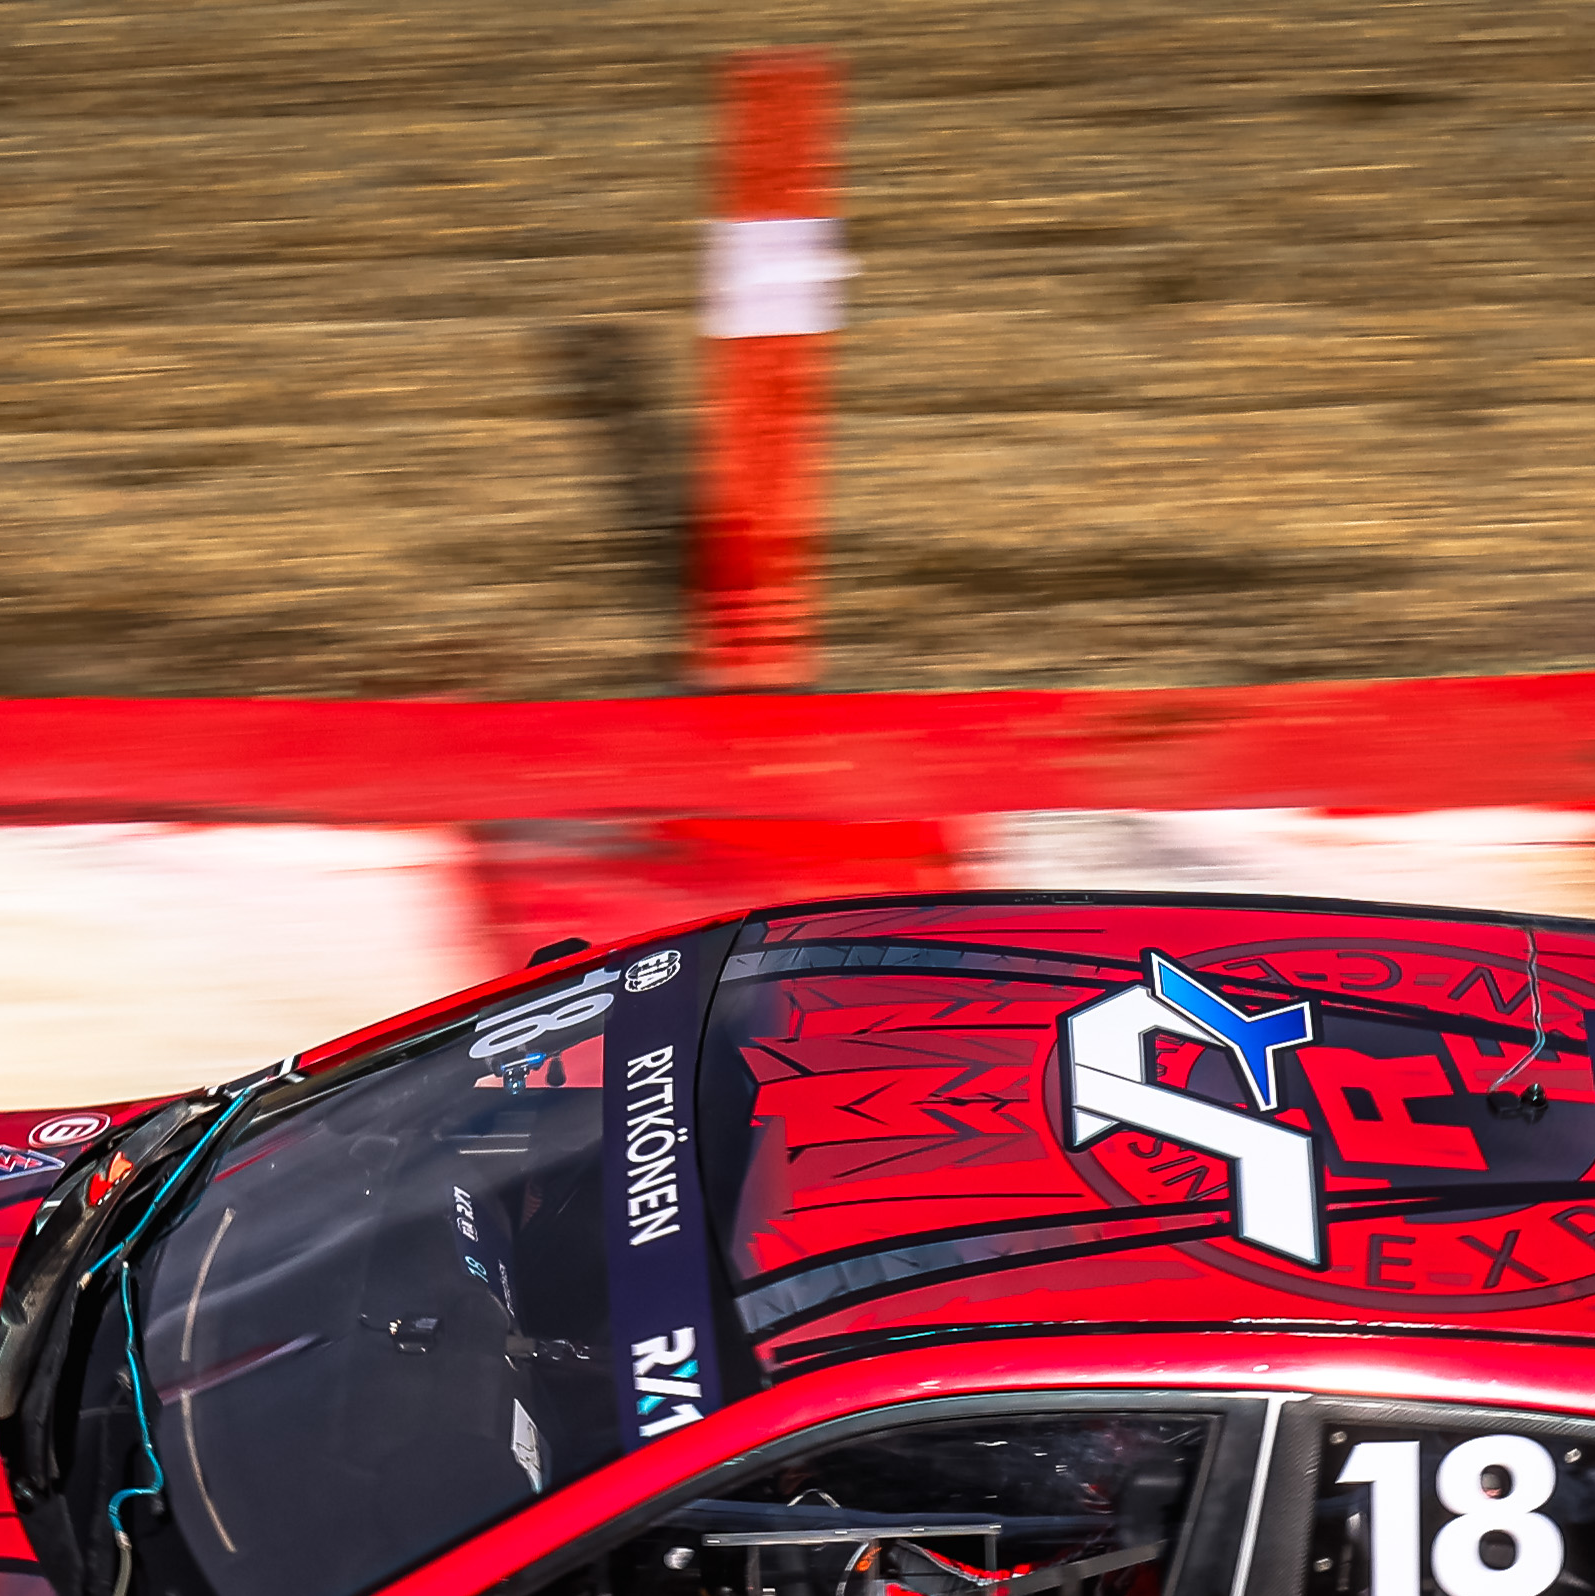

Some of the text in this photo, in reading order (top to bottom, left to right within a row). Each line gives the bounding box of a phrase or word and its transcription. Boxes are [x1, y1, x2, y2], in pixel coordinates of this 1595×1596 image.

[469, 967, 621, 1059] 18
[626, 1044, 689, 1247] RYTKÖNEN
[630, 1326, 706, 1438] RX1
